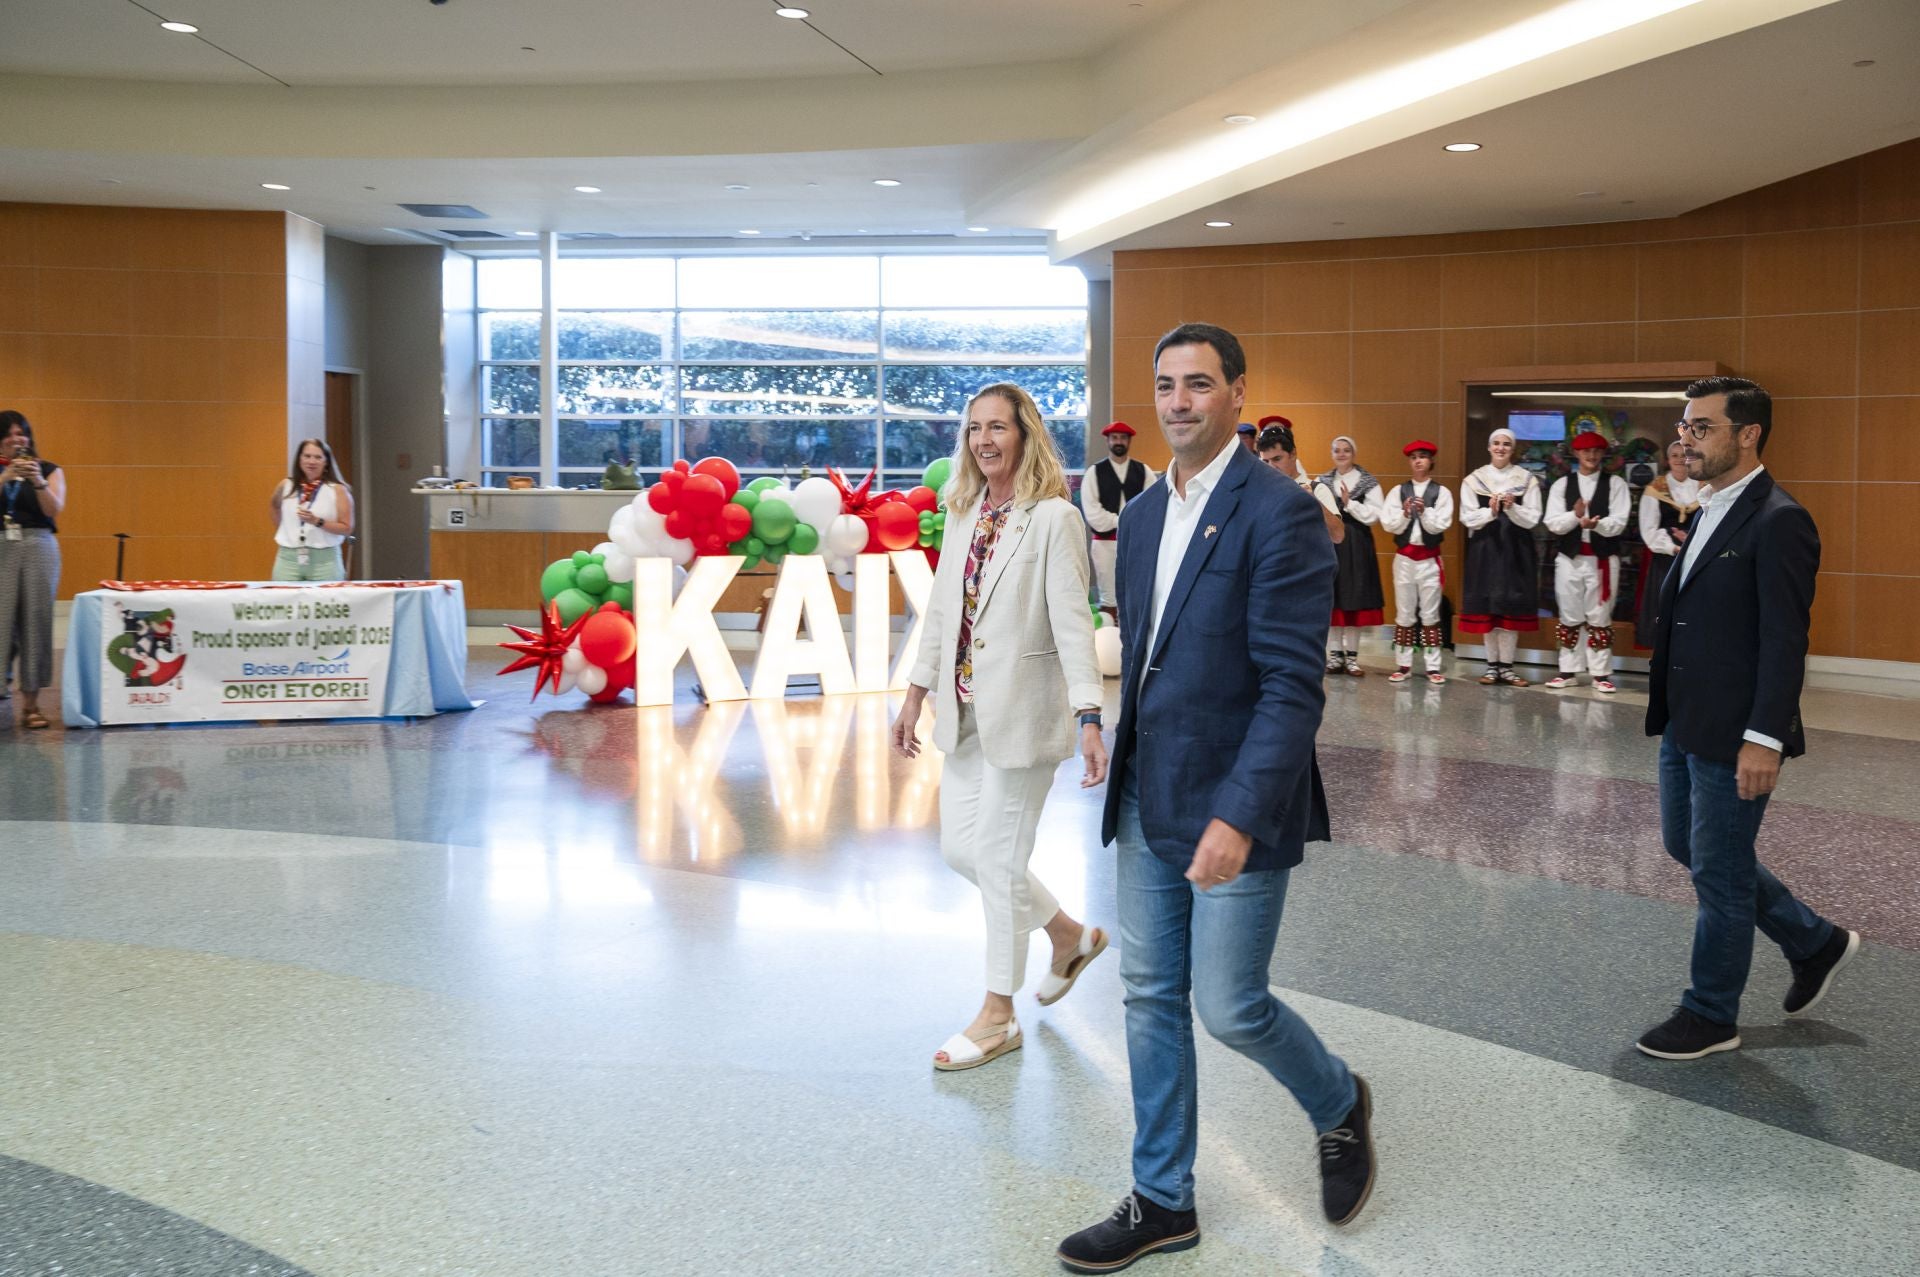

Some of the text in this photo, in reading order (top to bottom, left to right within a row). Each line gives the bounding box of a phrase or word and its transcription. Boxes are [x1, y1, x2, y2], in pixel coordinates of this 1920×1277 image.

[233, 599, 350, 620] Welcome to Boise
[192, 625, 389, 652] Proud sponsor of Jaialdi 2025
[242, 660, 349, 676] Boise Airport
